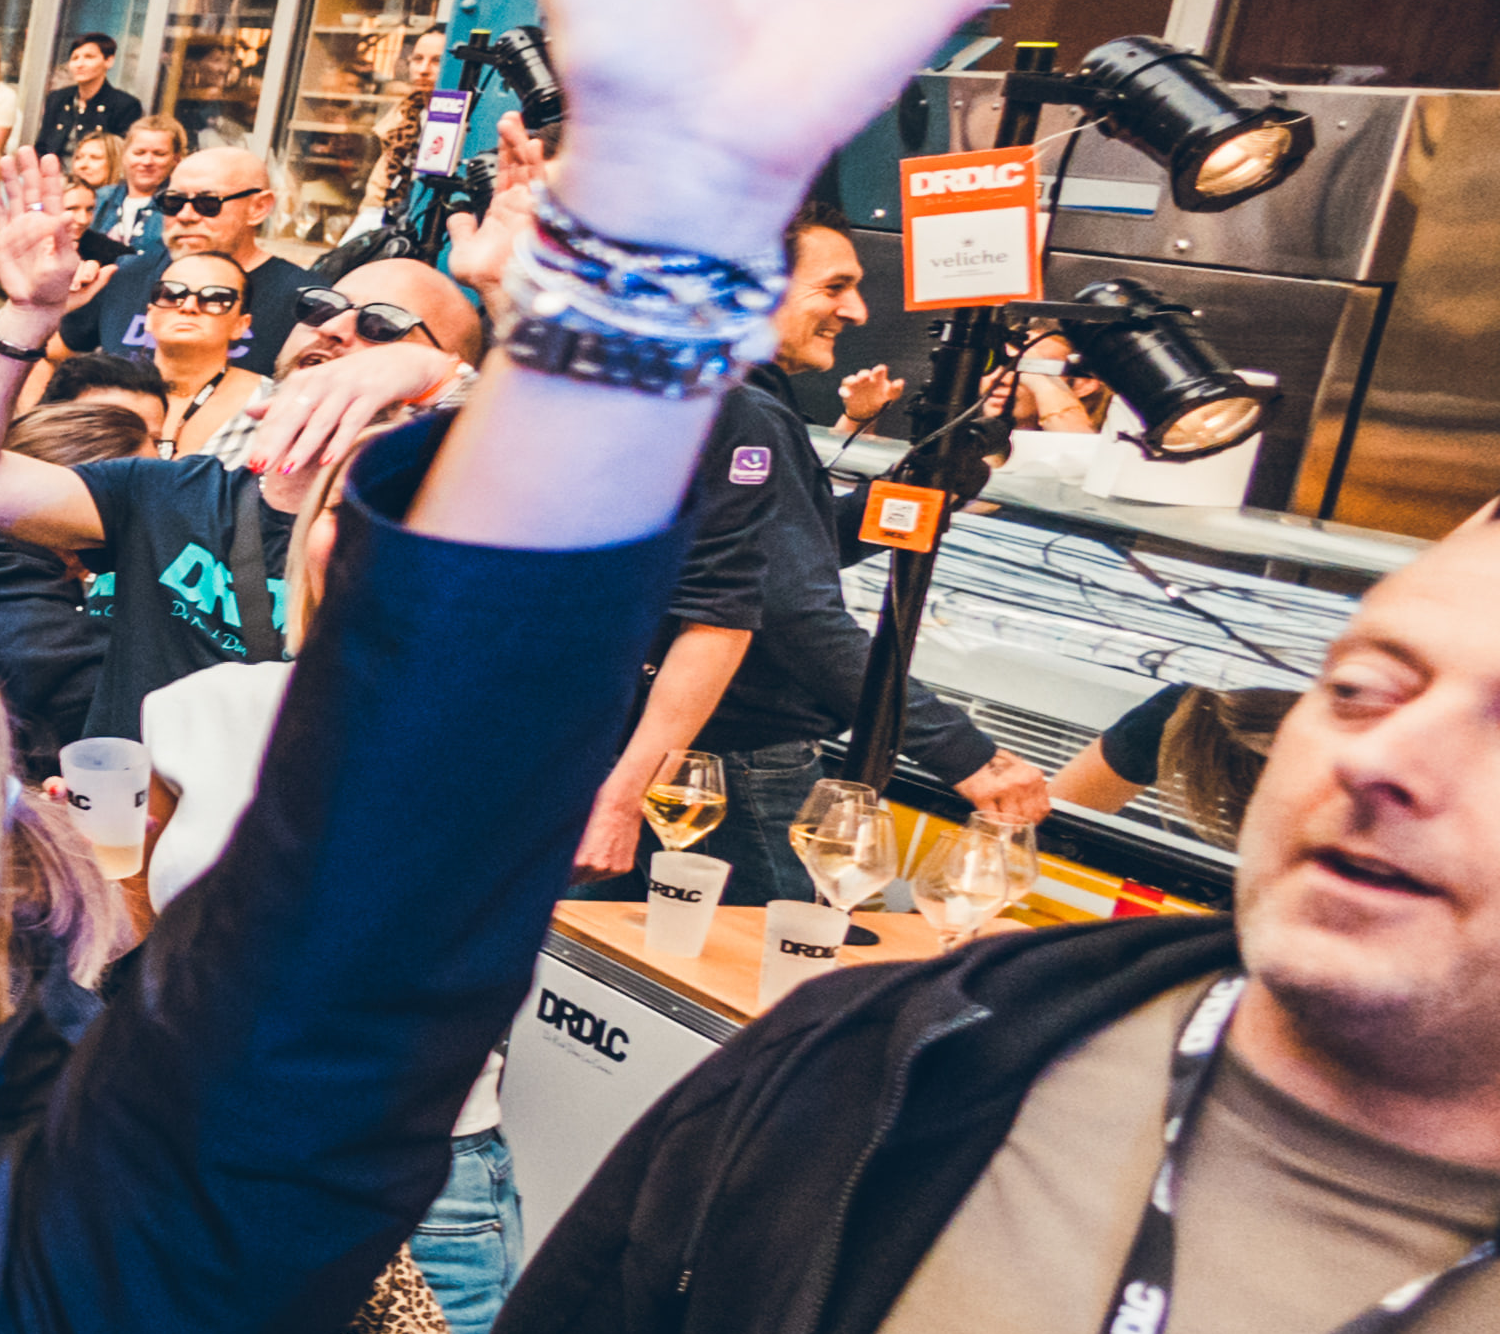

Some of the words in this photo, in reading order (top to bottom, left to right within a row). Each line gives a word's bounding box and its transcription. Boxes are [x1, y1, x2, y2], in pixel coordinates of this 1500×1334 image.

[909, 162, 1026, 197] DRDLC
[929, 249, 1009, 269] veliche
[537, 987, 630, 1063] DRDLC
